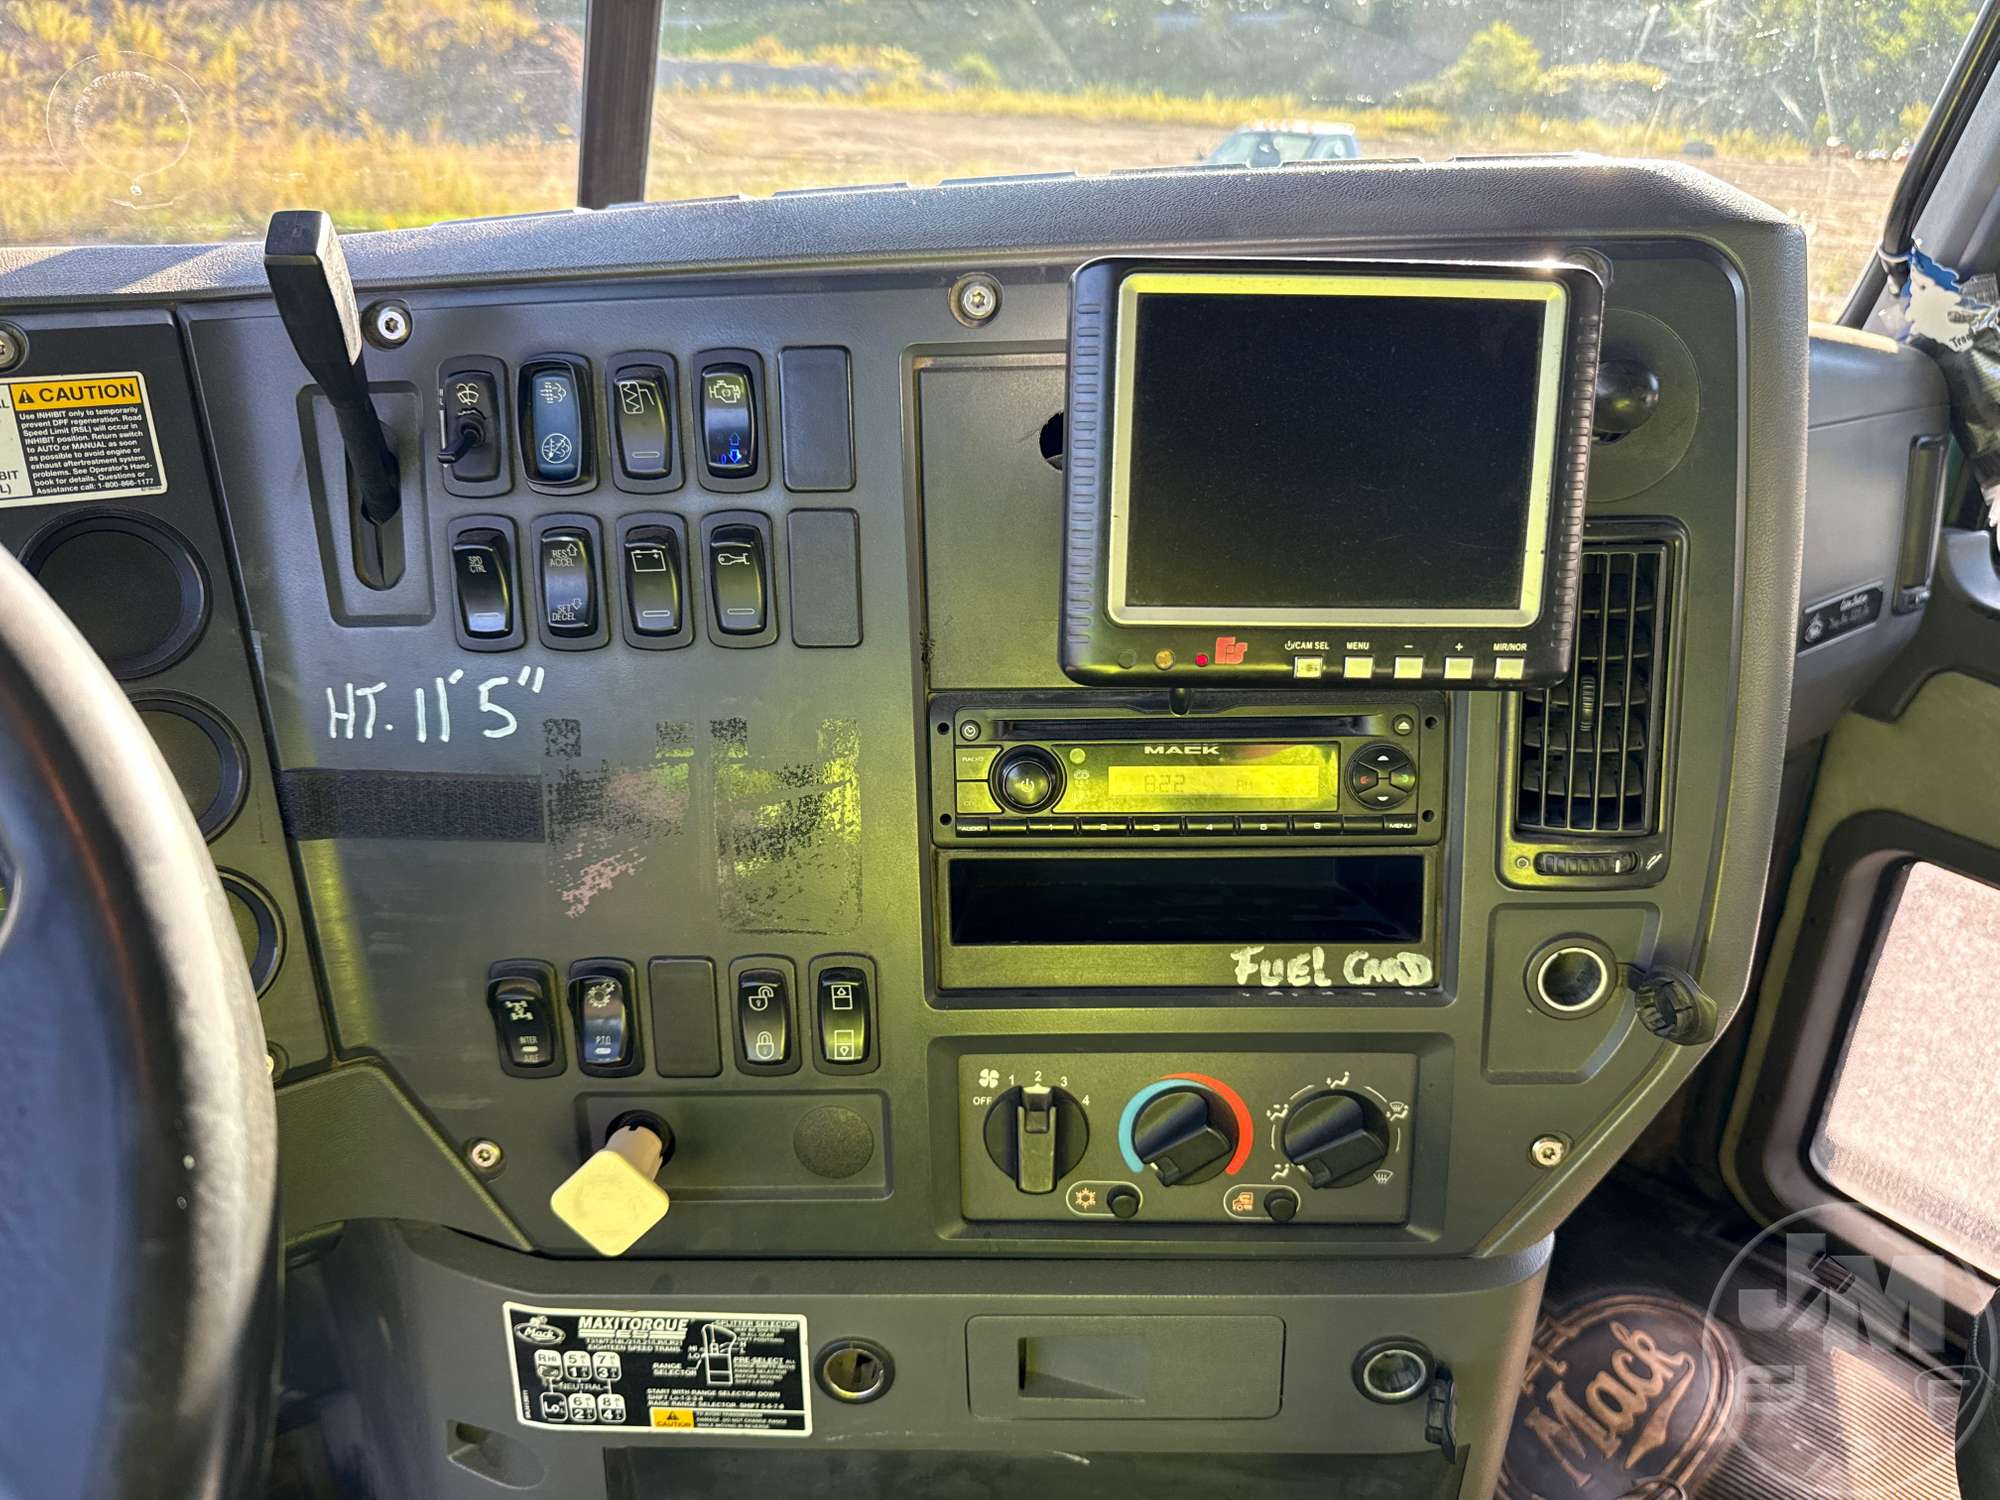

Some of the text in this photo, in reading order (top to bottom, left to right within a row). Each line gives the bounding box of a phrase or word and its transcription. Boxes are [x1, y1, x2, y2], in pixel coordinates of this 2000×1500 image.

[39, 383, 135, 402] CAUTION
[37, 410, 66, 419] INHIBIT
[68, 410, 84, 418] only
[96, 407, 138, 417] temporarily
[21, 420, 50, 429] prevent
[71, 417, 121, 426] regeneration.
[23, 428, 48, 437] Speed
[50, 426, 69, 435] Limit
[71, 425, 91, 434] (RSL)
[25, 437, 54, 445] INHIBIT
[57, 435, 89, 444] position.
[37, 445, 59, 453] AUTO
[72, 442, 106, 450] MANUAL
[40, 452, 72, 462] possible
[84, 449, 105, 457] avoid
[107, 449, 131, 457] engine
[31, 462, 61, 470] exhaust
[63, 457, 117, 467] aftertreatment
[33, 470, 70, 479] problems.
[90, 465, 128, 475] Operator's
[69, 475, 96, 483] details.
[98, 473, 135, 481] Questions
[37, 486, 78, 495] Assistance
[552, 549, 567, 559] RES
[550, 558, 575, 567] ACCEL
[552, 612, 576, 621] DECEL
[1314, 641, 1330, 650] SEL
[1346, 642, 1370, 650] MENU
[1493, 642, 1528, 652] MIR/NOR
[326, 682, 394, 740] HT.
[1144, 746, 1220, 755] MACK
[1230, 946, 1332, 987] FUEL
[1009, 1074, 1015, 1085] 1
[1034, 1071, 1042, 1082] 2
[1060, 1076, 1068, 1087] 3
[972, 1096, 992, 1105] OFF
[1081, 1095, 1090, 1106] 4
[578, 1316, 689, 1332] MAXITORQUE
[755, 1320, 797, 1328] SELECTOR
[523, 1326, 557, 1341] Mack
[538, 1354, 546, 1362] R
[568, 1354, 577, 1363] 5
[598, 1355, 606, 1364] 7
[652, 1362, 682, 1370] RANGE
[570, 1368, 578, 1377] 1
[598, 1368, 609, 1378] 3
[653, 1369, 697, 1377] SELECTOR
[560, 1382, 604, 1391] NEUTRAL
[573, 1396, 583, 1406] 6
[602, 1397, 611, 1406] 8
[1524, 1321, 1695, 1487] Mack
[544, 1400, 560, 1413] Lo
[574, 1409, 584, 1419] 2
[603, 1410, 613, 1419] 4
